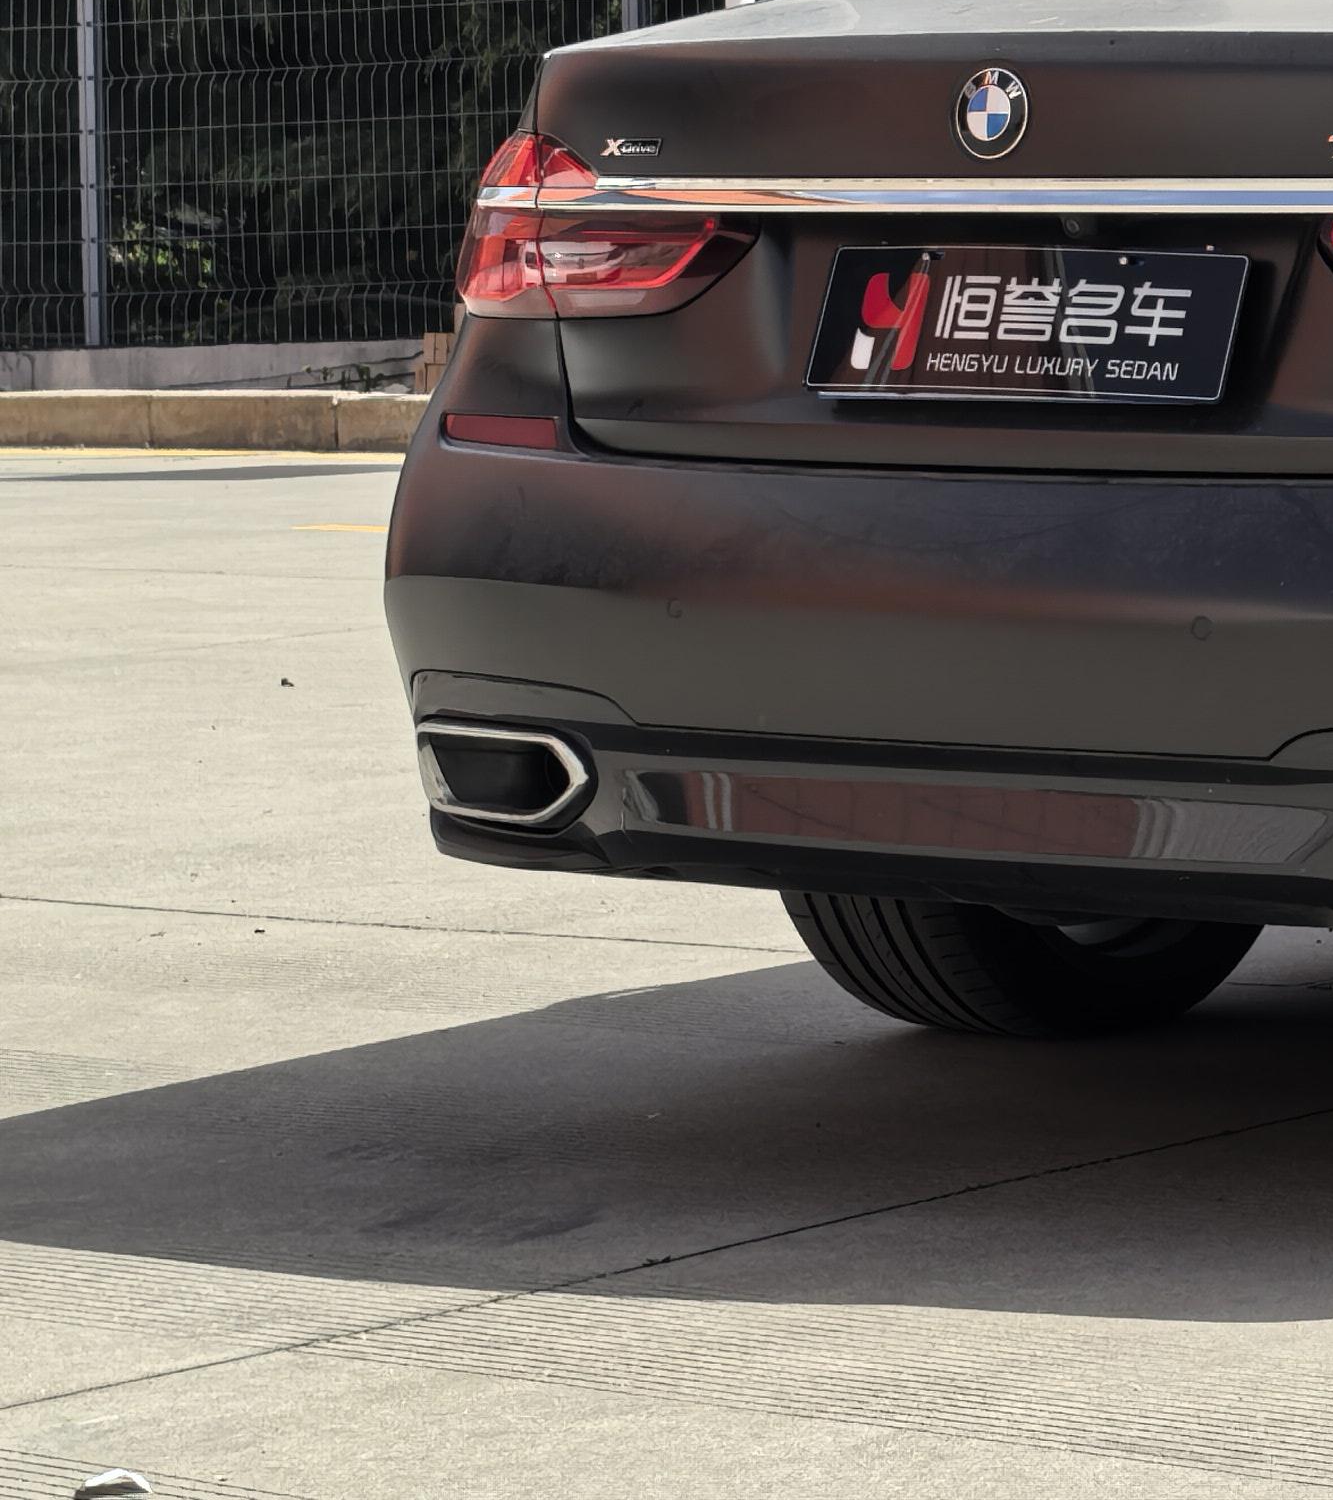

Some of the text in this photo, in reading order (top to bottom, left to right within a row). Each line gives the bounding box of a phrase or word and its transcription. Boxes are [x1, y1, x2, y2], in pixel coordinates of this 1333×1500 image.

[964, 70, 1022, 100] BMW
[934, 275, 1193, 347] 恒誉名车
[926, 352, 1180, 382] HENGYU LUXURY SEDAN
